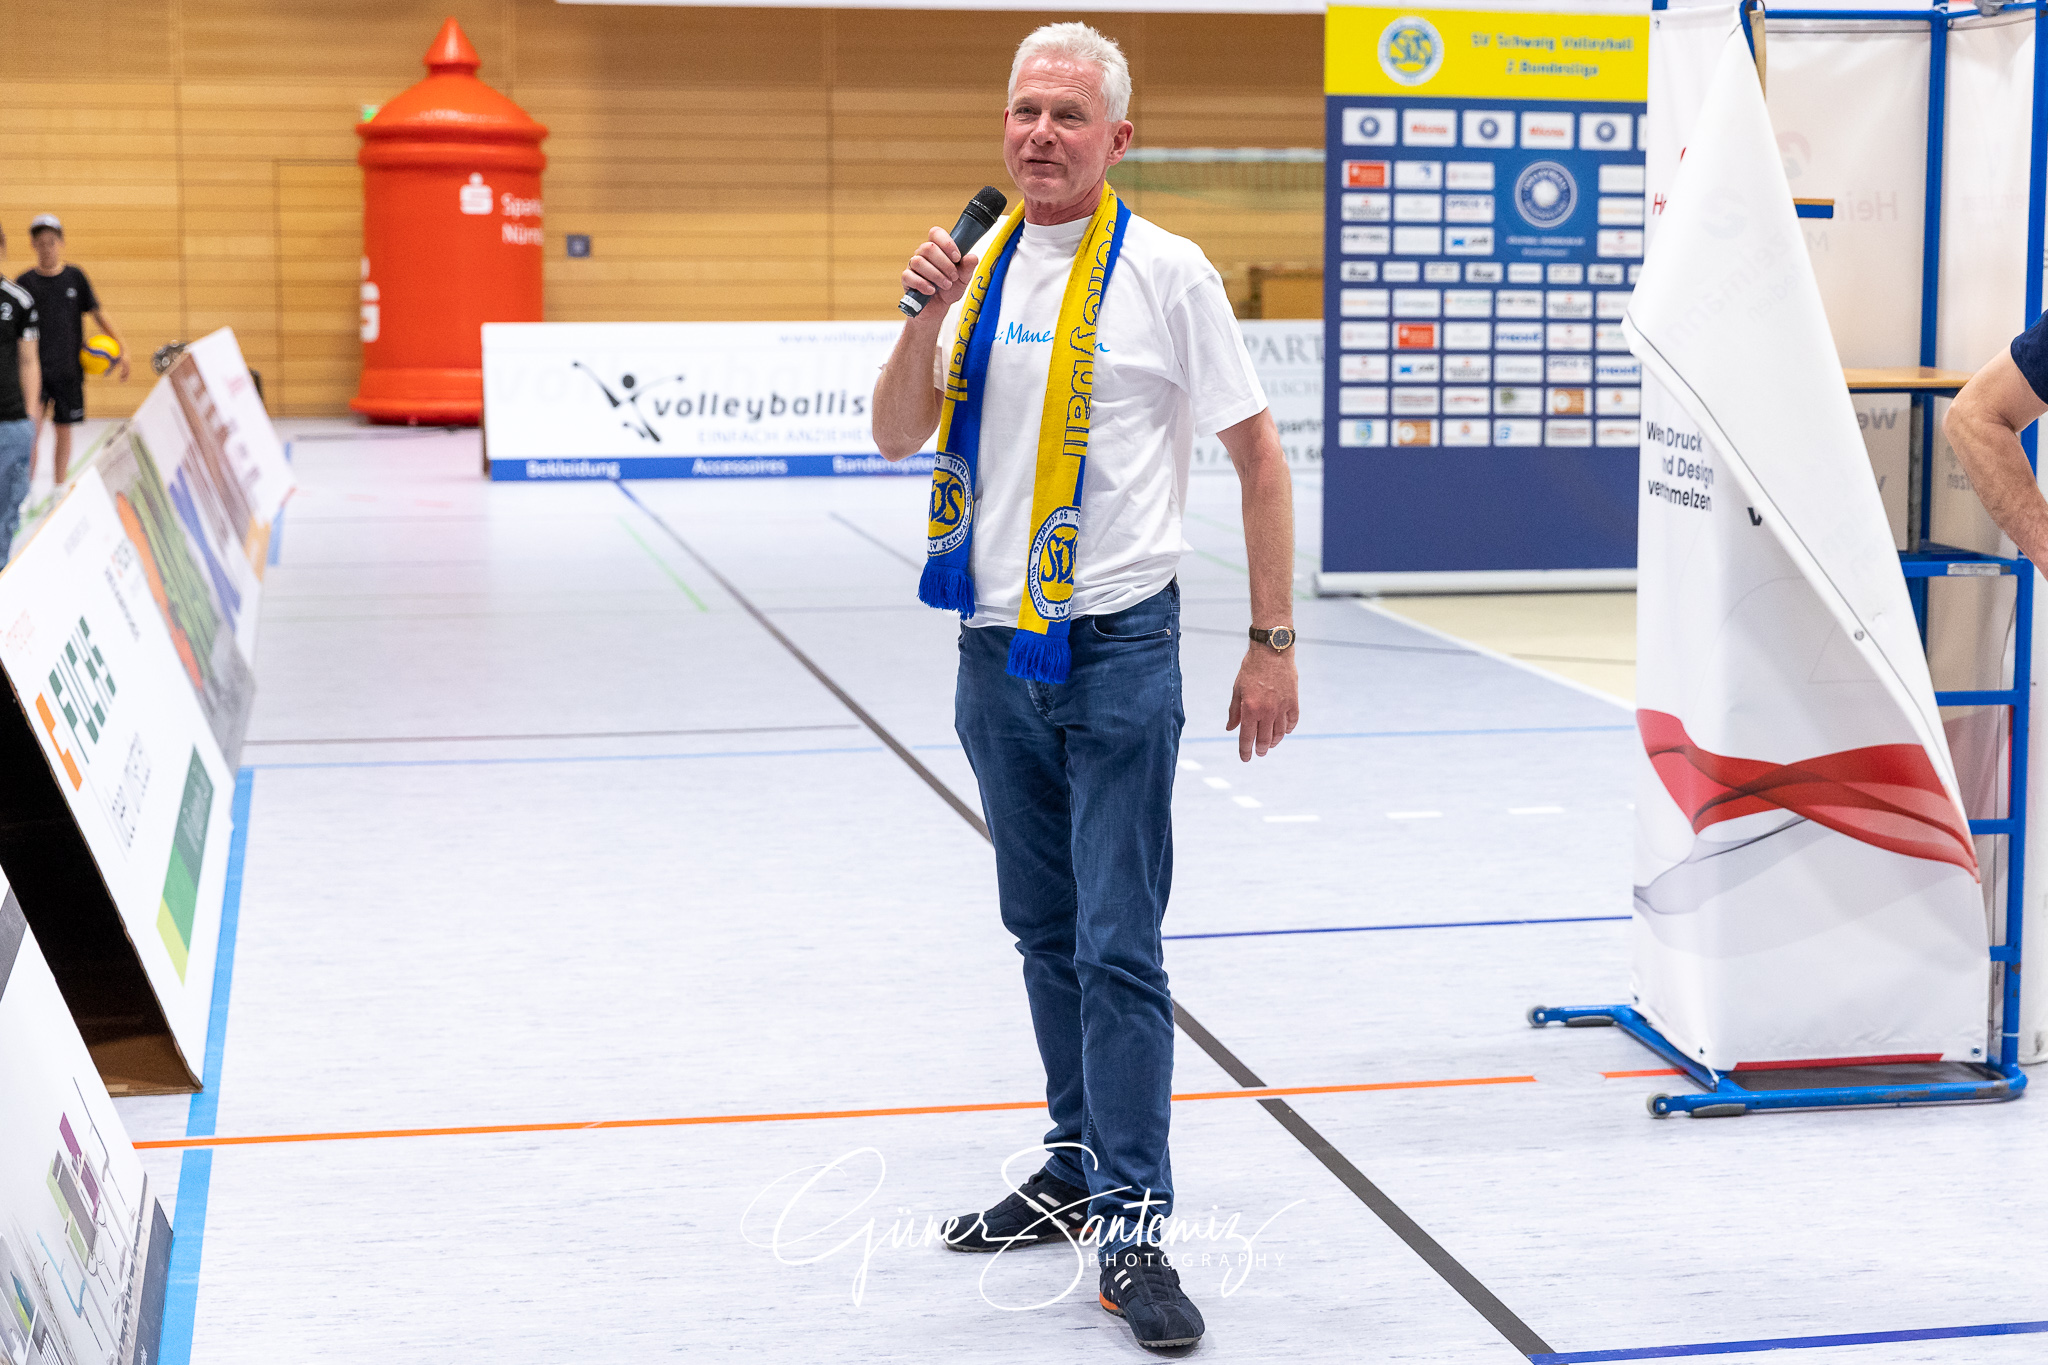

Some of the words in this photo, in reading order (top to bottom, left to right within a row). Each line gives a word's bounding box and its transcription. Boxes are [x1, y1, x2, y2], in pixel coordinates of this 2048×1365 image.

[654, 390, 866, 423] volleyballis
[1667, 428, 1702, 452] Druck
[526, 459, 620, 480] Bekleidung
[692, 458, 789, 476] Accessoires
[1677, 458, 1714, 489] Design
[48, 615, 117, 766] FUCHS
